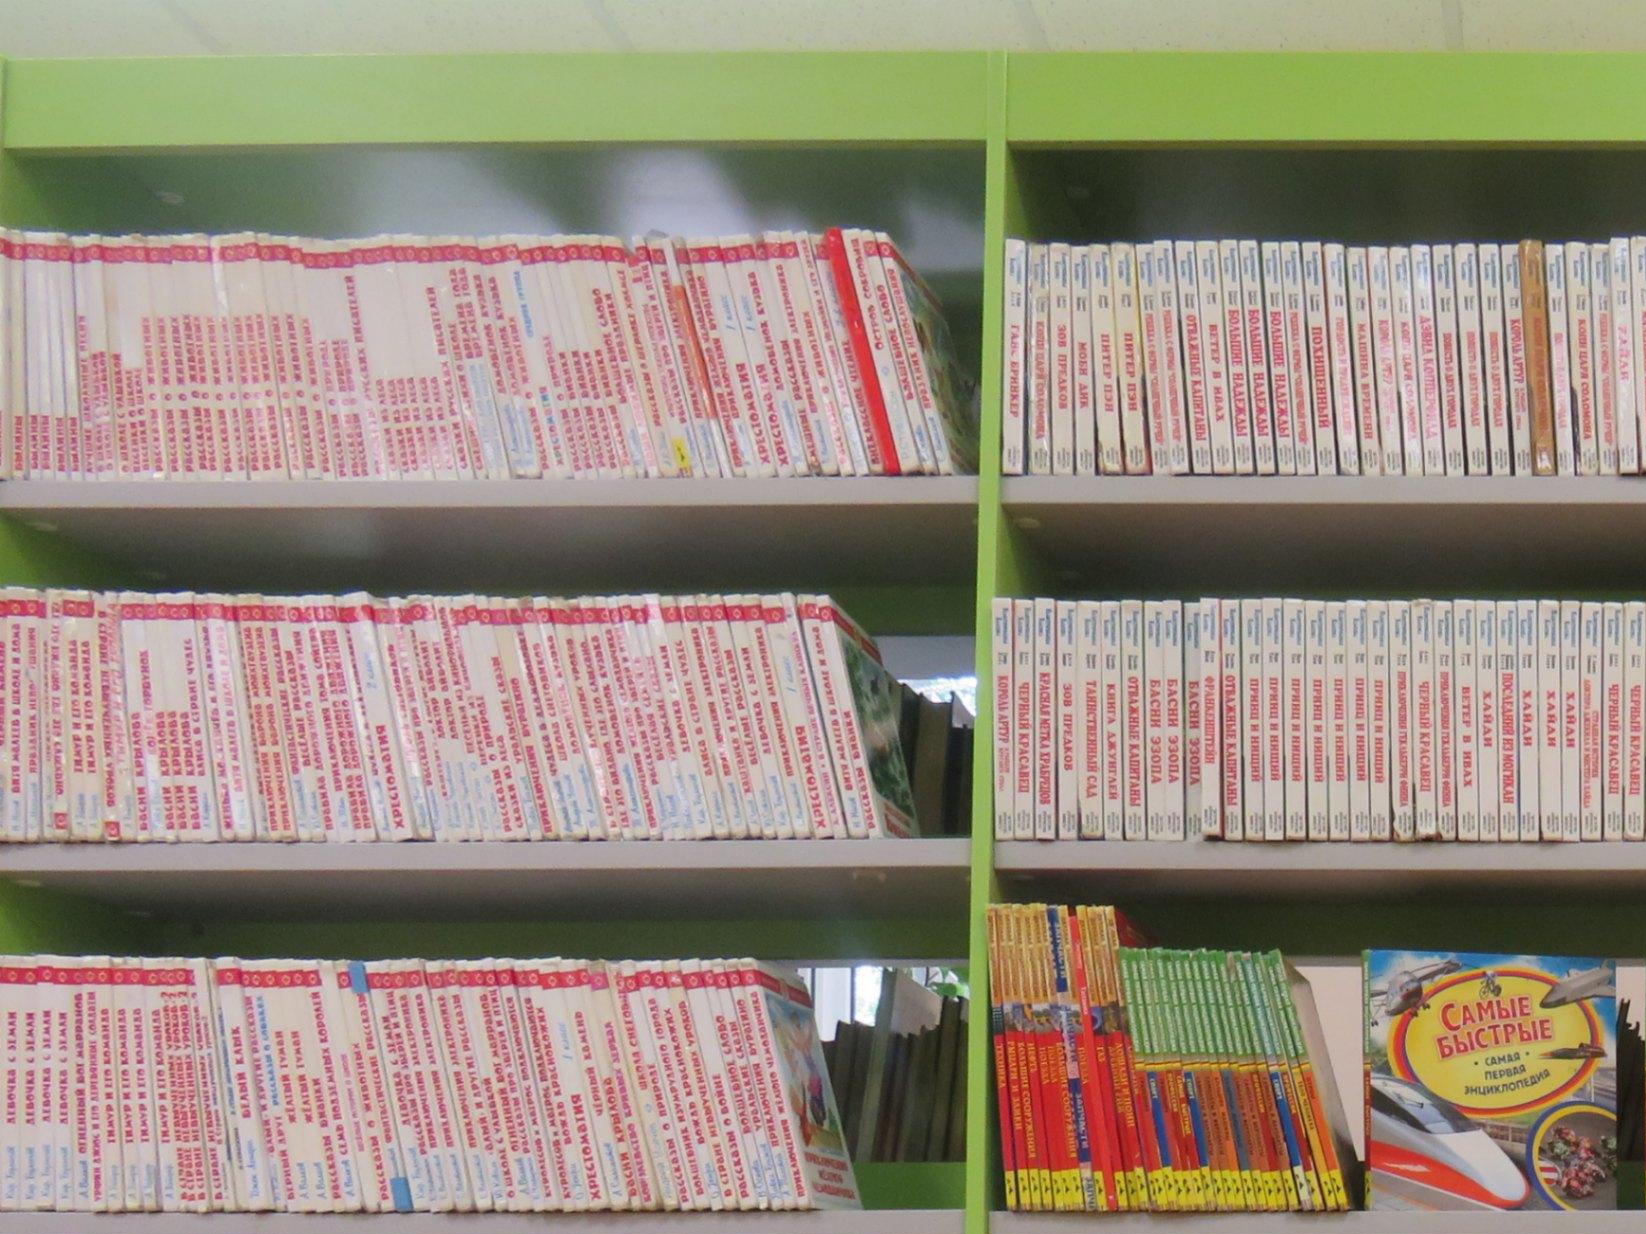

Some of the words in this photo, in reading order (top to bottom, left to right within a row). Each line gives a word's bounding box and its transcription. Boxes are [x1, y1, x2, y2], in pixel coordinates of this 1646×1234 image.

[1124, 333, 1135, 378] ПИТЕР
[1209, 324, 1220, 363] ВЕТЕР
[1248, 309, 1262, 366] БОЛЬШИЕ
[1358, 324, 1369, 378] МАШИНА
[1126, 383, 1137, 411] ПЭН
[1312, 327, 1331, 428] ПОХИЩЕННЫЙ
[736, 363, 771, 465] ХРЕСТОМАТИЯ
[1214, 387, 1224, 421] ИВАХ
[1254, 373, 1269, 437] НАДЕЖДЫ
[1361, 384, 1373, 439] ВРЕМЕНИ
[1127, 676, 1140, 740] ОТВАЖНЫЕ
[1166, 679, 1178, 727] БАСНИ
[1204, 676, 1216, 764] ФРАНКЕНШТЕЙН
[1269, 677, 1279, 719] ПРИНЦ
[1461, 686, 1471, 727] ВЕТЕР
[1502, 673, 1515, 735] ПОСЛЕДНИЙ
[1523, 690, 1534, 747] ХАЙДИ
[1085, 680, 1098, 773] ТАИНСТВЕННЫЙ
[1269, 723, 1279, 731] И
[1463, 735, 1471, 743] В
[1502, 736, 1514, 751] ИЗ
[1129, 743, 1141, 807] КАПИТАНЫ
[1168, 736, 1179, 784] ЭЗОПА
[1270, 735, 1281, 781] НИЩИЙ
[1462, 751, 1472, 787] ИВАХ
[1503, 754, 1514, 804] МОГИКАН
[1608, 735, 1619, 794] КРАСАВЕЦ
[1086, 775, 1097, 798] САД
[8, 1012, 17, 1051] ЗЕМЛИ
[74, 993, 83, 1059] МАРРАНОВ
[1441, 996, 1531, 1032] САМЫЕ
[1436, 1019, 1552, 1058] БЫСТРЫЕ
[1485, 1052, 1521, 1066] САМАЯ
[76, 1064, 85, 1084] БОГ
[1465, 1068, 1550, 1096] ЭНЦИКЛОПЕДИЯ
[1485, 1064, 1526, 1080] ПЕРВАЯ
[7, 1069, 17, 1124] ДЕВОЧКА
[75, 1088, 86, 1153] ОГНЕННЫЙ
[1021, 1091, 1035, 1158] СООРУЖЕНИЯ
